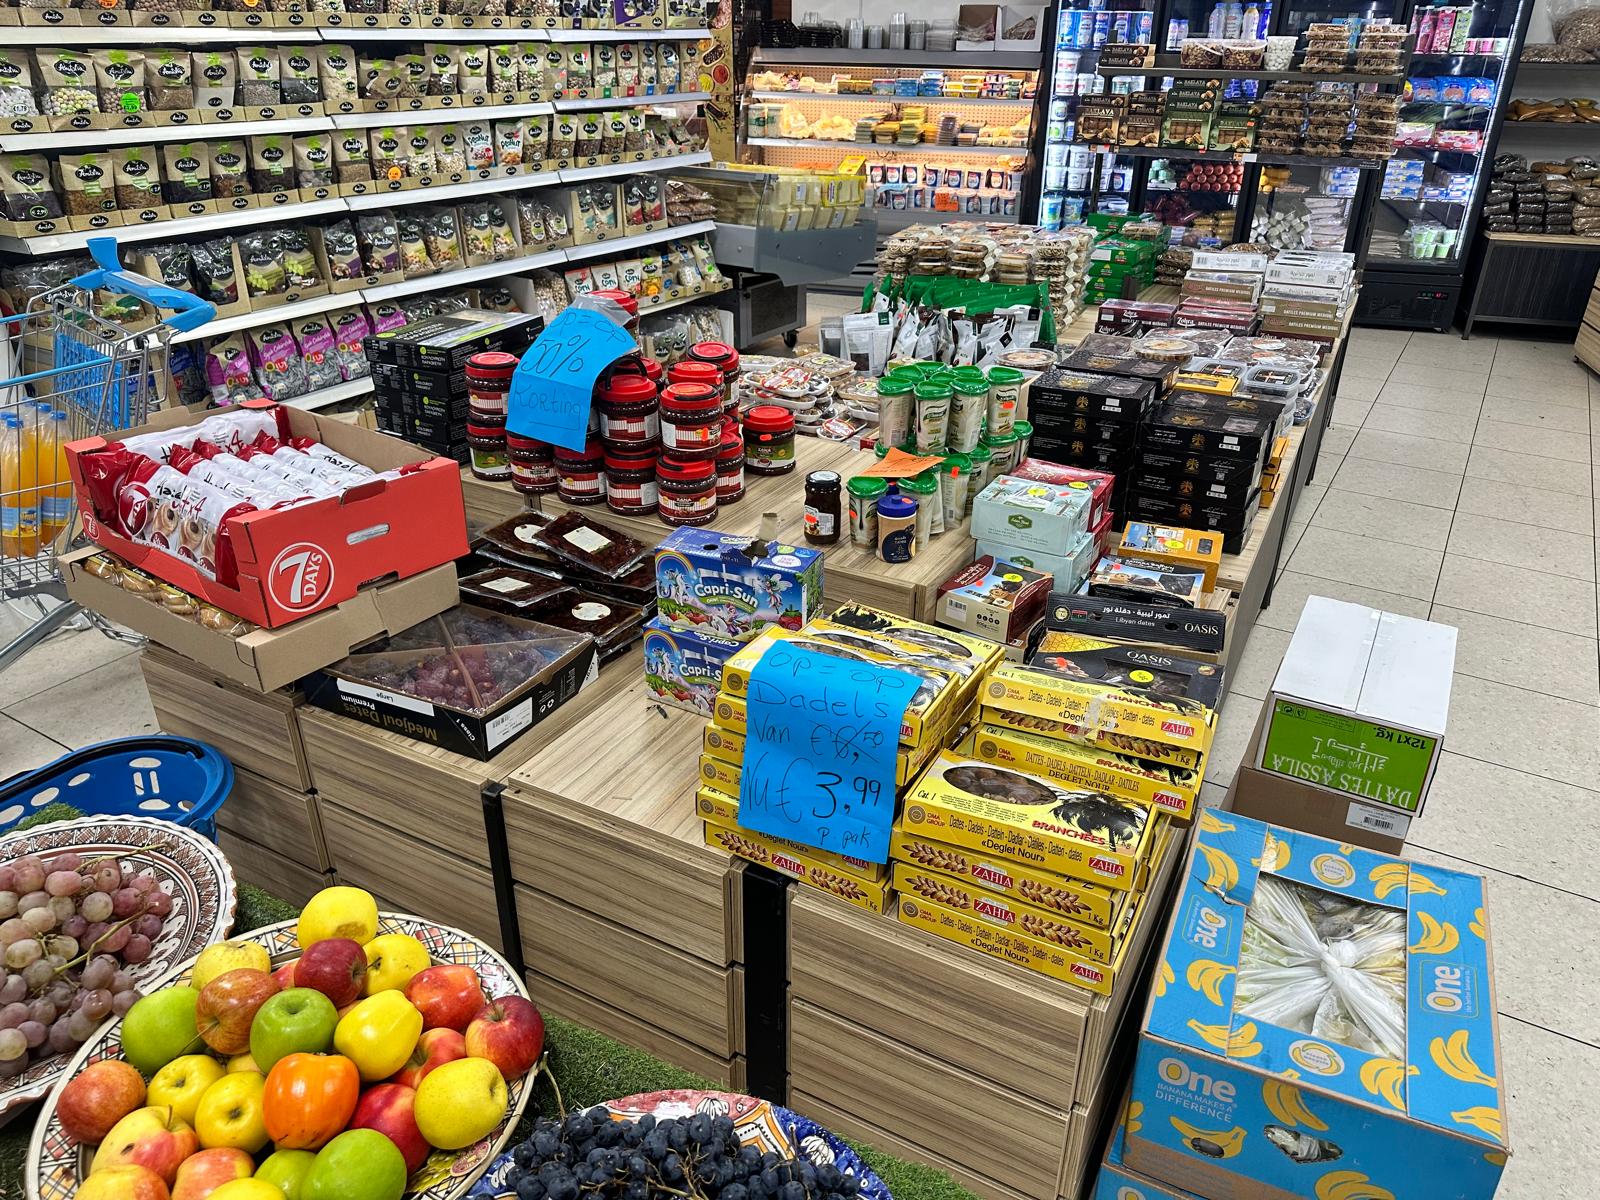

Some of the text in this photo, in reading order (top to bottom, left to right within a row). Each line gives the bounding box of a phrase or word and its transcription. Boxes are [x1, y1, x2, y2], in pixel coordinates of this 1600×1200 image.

[520, 335, 591, 378] 50%
[279, 552, 322, 603] 7 DAYS
[694, 583, 759, 609] Capri-Sun
[1115, 616, 1156, 627] Libyan dates
[1184, 622, 1219, 635] OASIS
[1127, 651, 1173, 666] OASIS
[679, 663, 721, 681] Capri-S
[341, 694, 375, 710] Premium
[377, 692, 394, 702] Large
[747, 678, 890, 718] Dadels
[1006, 693, 1024, 701] GROUP
[344, 703, 437, 741] Medjoul Dates
[753, 714, 791, 744] Van
[1142, 715, 1155, 726] dates
[1162, 722, 1194, 736] ZAHIA
[461, 724, 475, 741] Class
[986, 727, 998, 736] Cat.
[1373, 727, 1427, 750] 12x1 kg.
[722, 743, 738, 753] GROUP
[998, 753, 1015, 763] GROUP
[1180, 756, 1190, 765] Kg
[1025, 752, 1043, 766] DATTES
[1047, 757, 1066, 772] DADELS
[1069, 763, 1091, 778] DATTELN
[1094, 769, 1115, 785] DADLAR
[1272, 753, 1336, 785] ASSILA
[717, 774, 732, 784] GROUP
[741, 752, 769, 812] Nu
[1048, 770, 1110, 792] DEGLET NOUR
[918, 790, 929, 799] Cat.
[1339, 773, 1412, 809] DATTES
[1154, 794, 1187, 810] ZAHIA
[714, 810, 730, 819] GROUP
[927, 819, 945, 828] GROUP
[950, 815, 964, 830] Dattes
[968, 820, 984, 835] Dadels
[1008, 831, 1025, 845] Dadlar
[1068, 849, 1082, 862] dates
[772, 854, 805, 876] ZAHIA
[1090, 858, 1124, 875] ZAHIA
[973, 866, 1012, 889] ZAHIA
[919, 914, 937, 923] GROUP
[974, 900, 1014, 923] ZAHIA
[1093, 914, 1104, 925] Kg
[1194, 907, 1226, 948] One
[940, 913, 955, 926] Dattes
[958, 920, 973, 934] Dadels
[995, 932, 1010, 947] Dadlar
[1050, 953, 1064, 966] dates
[1094, 948, 1104, 960] Kg
[1071, 964, 1103, 982] ZAHIA
[1426, 966, 1463, 1011] One
[1158, 1057, 1237, 1103] One
[1155, 1090, 1232, 1123] DIFFERENCE
[1157, 1082, 1233, 1114] BANANA MAKES A
